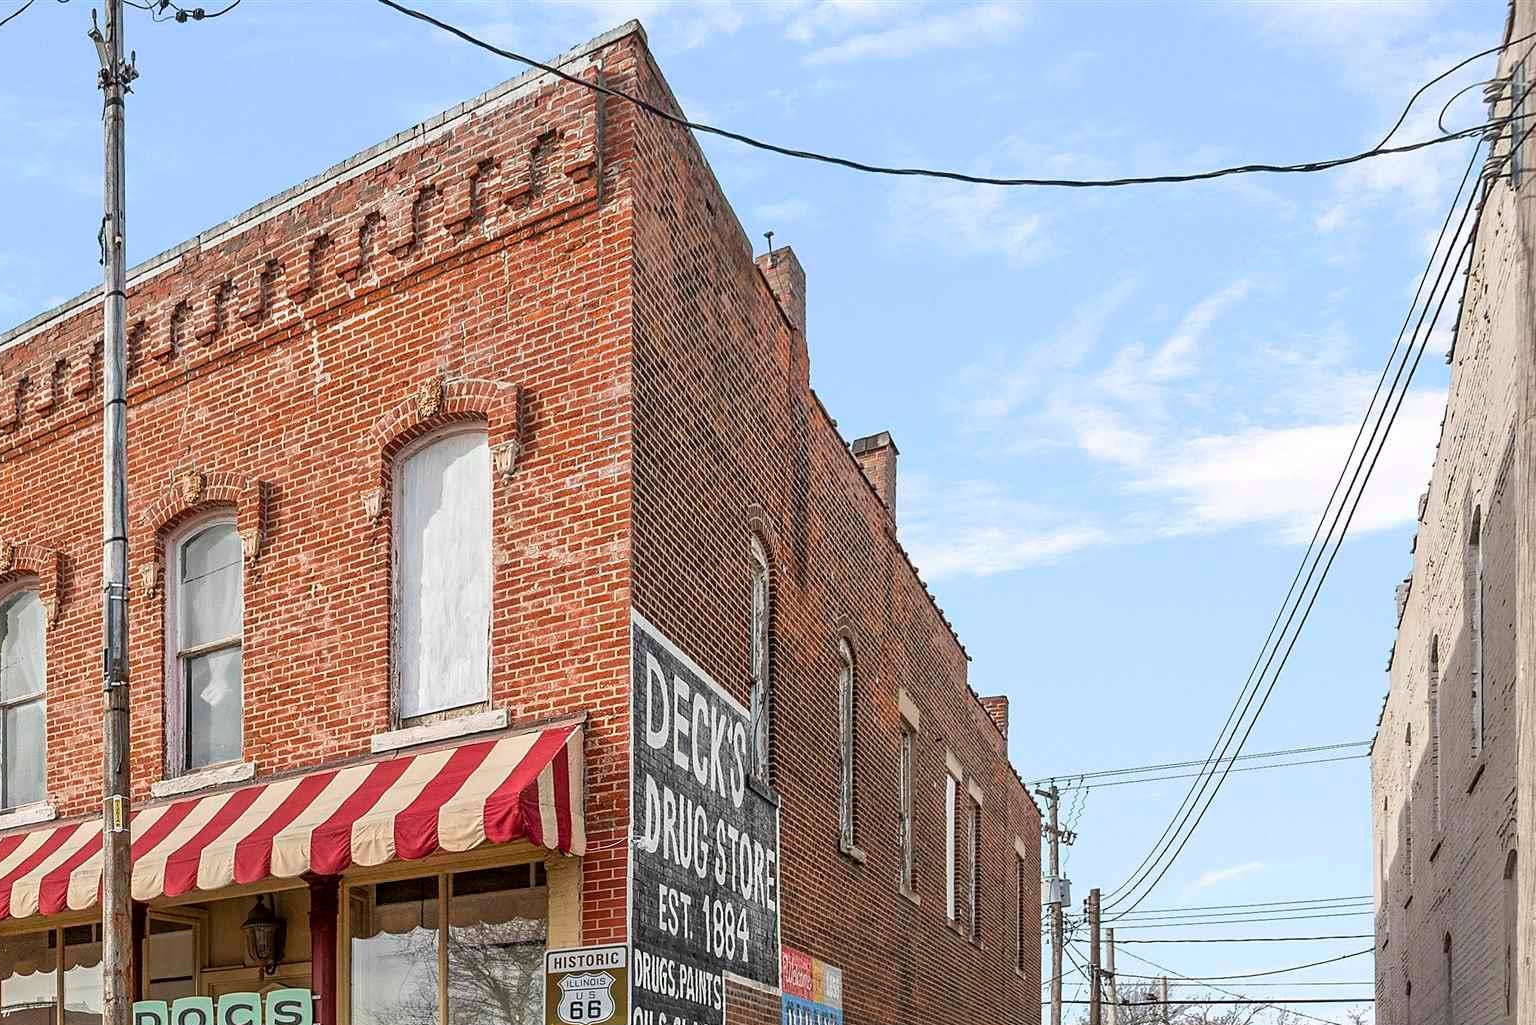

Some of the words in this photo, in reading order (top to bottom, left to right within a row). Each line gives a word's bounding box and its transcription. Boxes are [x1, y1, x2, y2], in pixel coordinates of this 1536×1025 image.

[646, 652, 746, 808] DECK'S
[645, 773, 708, 879] DRUG
[716, 818, 775, 912] STORE
[659, 884, 693, 940] EST.
[703, 895, 750, 963] 1884
[553, 952, 620, 970] HISTORIC
[566, 977, 606, 988] ILLINOIS
[569, 1000, 602, 1020] 66
